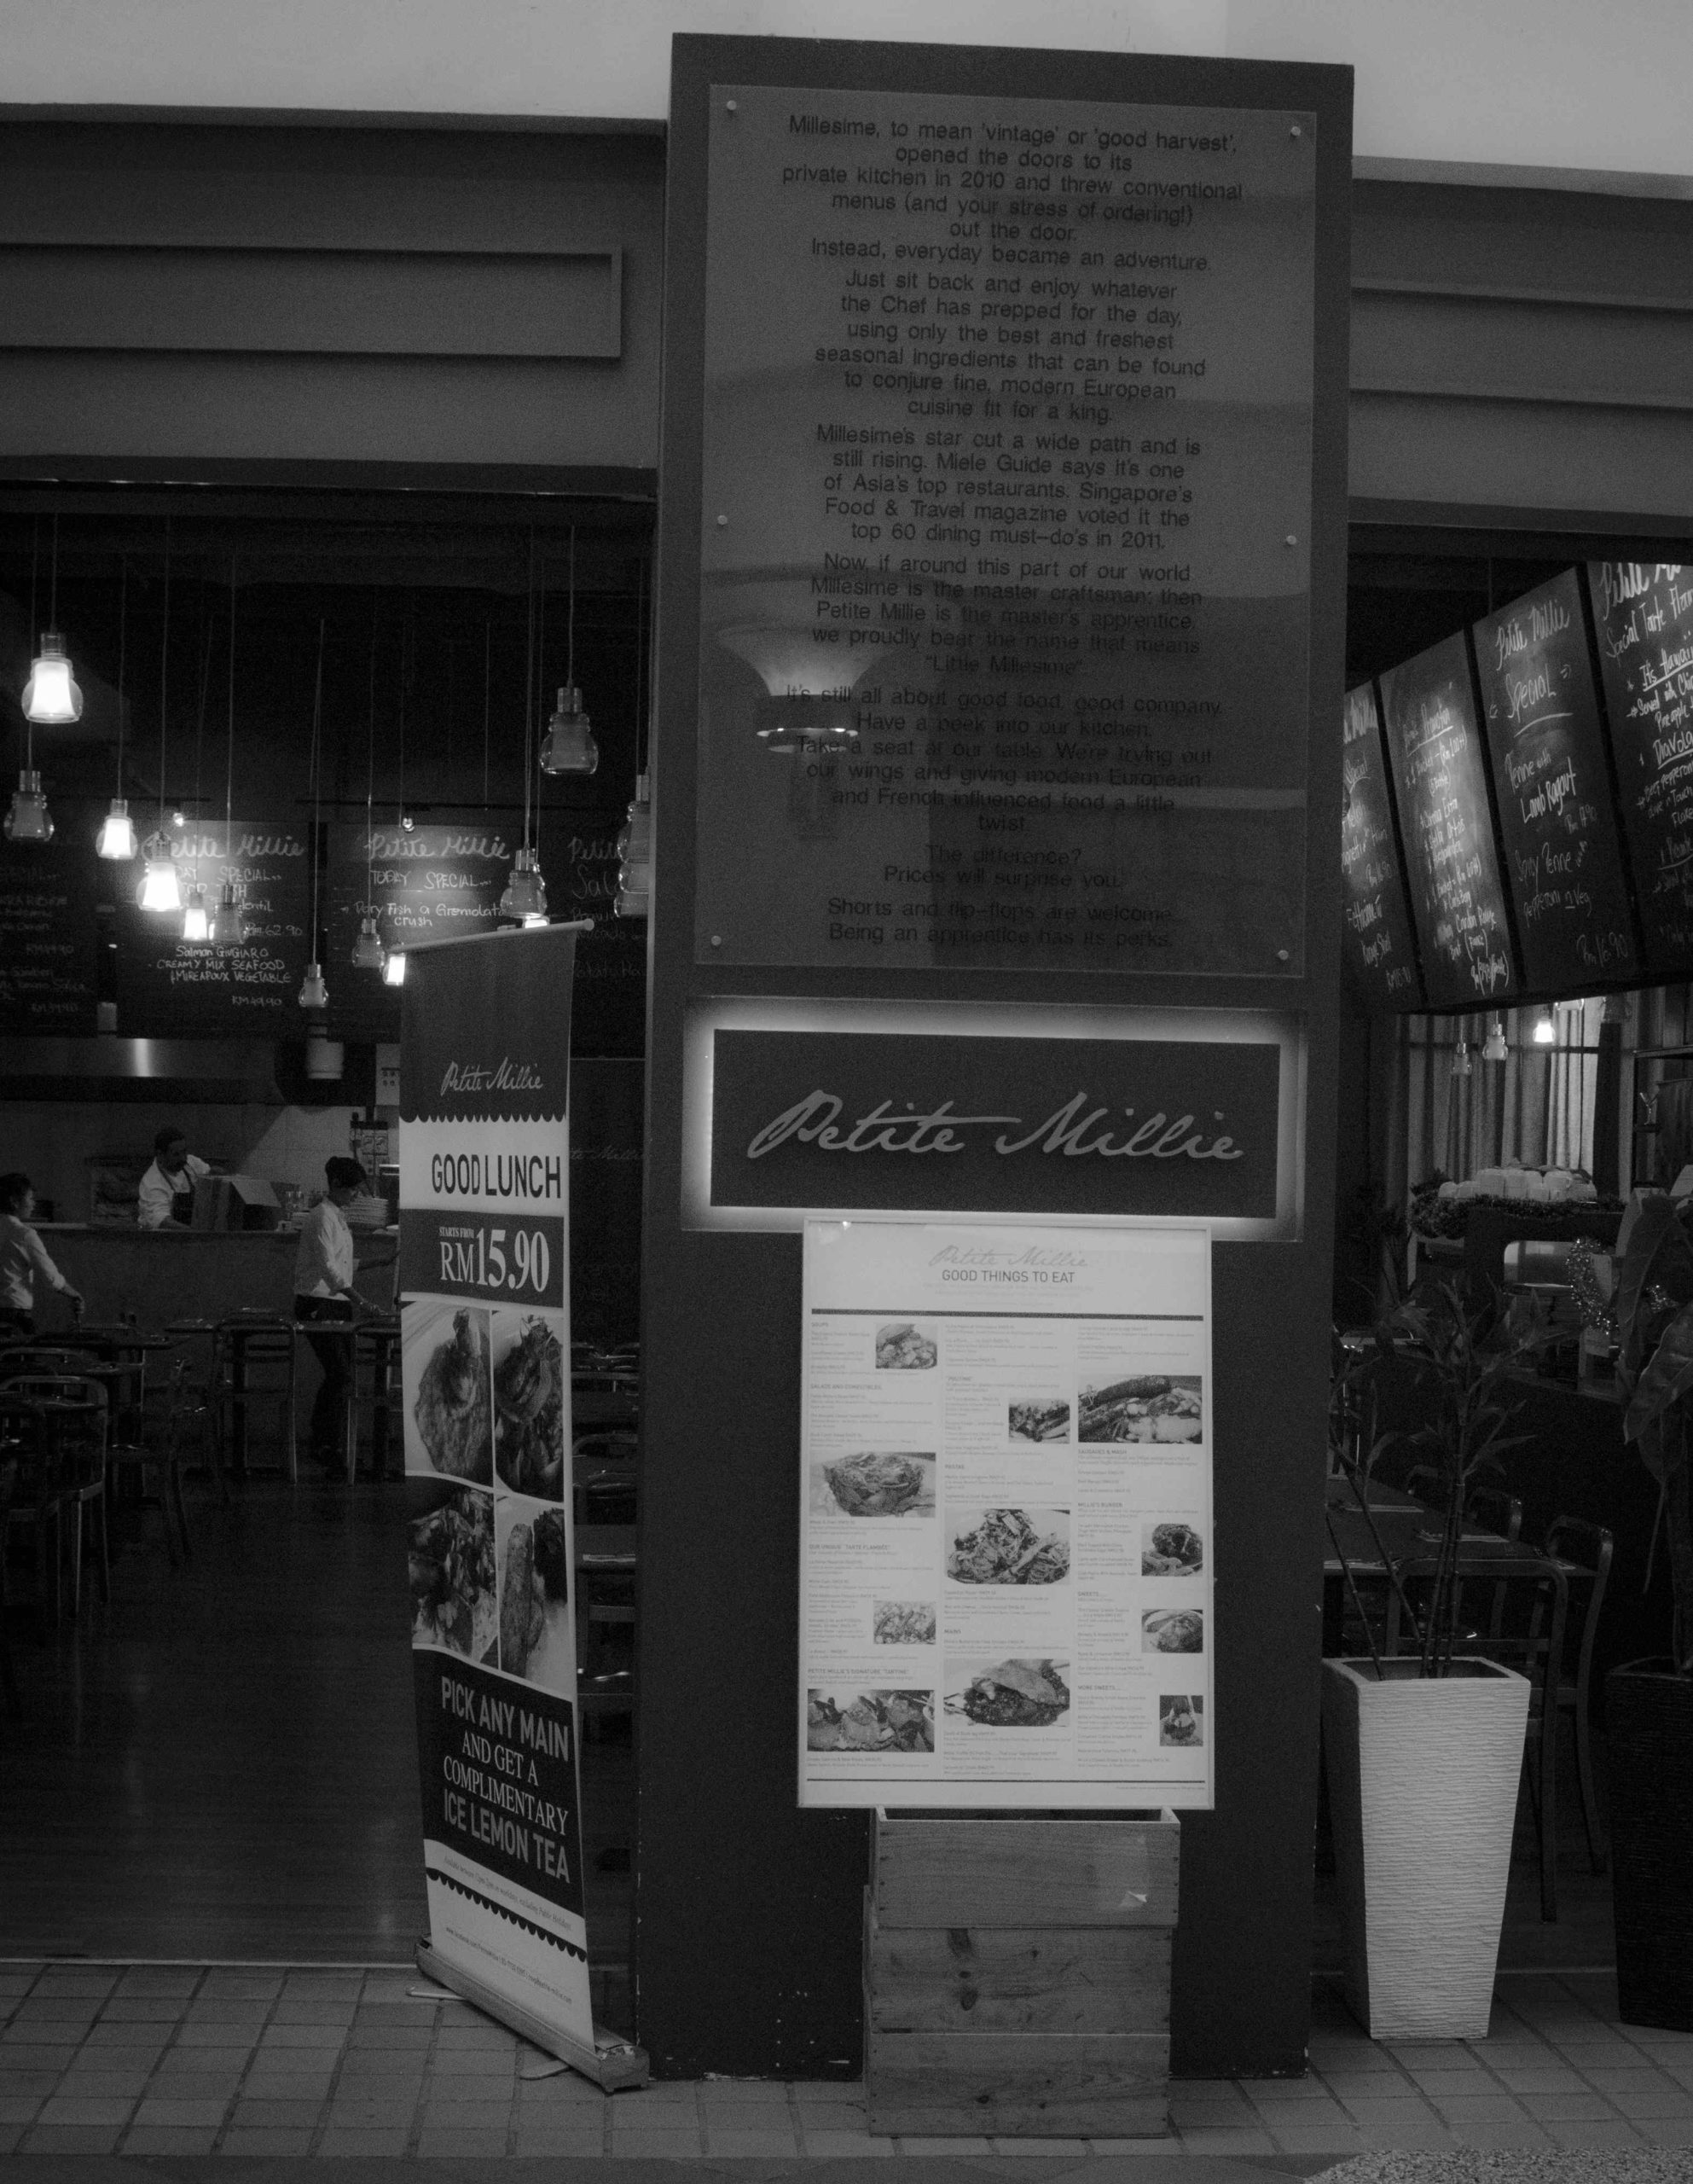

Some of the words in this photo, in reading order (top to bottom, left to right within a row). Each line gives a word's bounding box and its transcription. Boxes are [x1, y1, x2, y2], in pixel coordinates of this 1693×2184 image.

[890, 120, 907, 136] to
[918, 125, 971, 139] mean
[1067, 131, 1087, 144] or
[895, 147, 968, 165] opened
[978, 148, 1007, 165] the
[1018, 149, 1072, 168] doors
[1083, 154, 1101, 169] to
[1110, 154, 1132, 171] its
[781, 164, 847, 183] private
[856, 166, 926, 186] kitchen
[935, 170, 950, 187] in
[960, 171, 1005, 189] 2010
[1015, 175, 1050, 191] and
[1060, 176, 1111, 194] threw
[1122, 182, 1242, 200] conventional
[831, 194, 896, 209] menus
[903, 194, 948, 214] (and
[957, 200, 999, 217] your
[1009, 200, 1067, 217] stress
[1077, 202, 1095, 218] of
[949, 221, 980, 236] out
[989, 221, 1019, 238] the
[810, 237, 885, 258] Instead,
[895, 243, 981, 264] everyday
[991, 245, 1070, 264] became
[1081, 253, 1104, 265] an
[844, 269, 884, 287] Just
[896, 271, 918, 288] sit
[927, 272, 973, 290] back
[985, 276, 1021, 293] and
[1030, 278, 1080, 299] enjoy
[1091, 280, 1176, 299] whatever
[840, 293, 870, 311] the
[880, 295, 926, 313] Chef
[936, 298, 971, 315] has
[980, 302, 1061, 322] prepped
[1070, 303, 1095, 320] for
[1106, 305, 1136, 322] the
[846, 320, 898, 341] using
[907, 322, 946, 343] only
[958, 324, 988, 341] the
[997, 326, 1039, 343] best
[1049, 328, 1087, 346] and
[1096, 330, 1173, 349] freshest
[815, 346, 903, 363] seasonal
[912, 347, 1017, 369] ingredients
[1027, 352, 1063, 369] that
[1073, 357, 1109, 371] can
[1116, 356, 1142, 373] be
[1151, 357, 1206, 375] found
[844, 370, 862, 386] to
[873, 372, 942, 392] conjure
[1000, 377, 1074, 394] modern
[1083, 379, 1176, 401] European
[907, 398, 972, 415] cuisine
[983, 400, 1001, 416] fit
[1012, 401, 1036, 418] for
[1047, 405, 1058, 419] a
[925, 429, 961, 445] star
[971, 432, 1002, 447] cut
[1012, 435, 1023, 448] a
[1035, 433, 1079, 450] wide
[1088, 436, 1131, 455] path
[1140, 438, 1177, 454] and
[1185, 439, 1200, 455] is
[832, 449, 862, 466] still
[872, 450, 927, 472] rising.
[936, 452, 986, 470] Miele
[996, 455, 1051, 473] Guide
[1062, 461, 1105, 479] says
[1115, 460, 1139, 476] it's
[1149, 464, 1184, 478] one
[823, 473, 842, 490] of
[853, 473, 908, 492] Asia's
[916, 477, 947, 497] top
[1079, 482, 1192, 505] Singapore's
[824, 497, 876, 514] Food
[884, 498, 898, 515] &
[911, 500, 965, 518] Travel
[973, 504, 1066, 523] magazine
[1077, 508, 1129, 524] voted
[1138, 508, 1150, 525] it
[1159, 509, 1189, 526] the
[850, 524, 881, 544] top
[890, 525, 916, 542] 60
[925, 526, 981, 548] dining
[1095, 532, 1111, 549] in
[878, 555, 890, 571] if
[900, 557, 967, 573] around
[977, 558, 1010, 575] this
[1019, 561, 1059, 580] part
[1069, 562, 1087, 578] of
[1096, 566, 1127, 579] our
[1138, 566, 1191, 582] world
[363, 834, 434, 862] Petite
[444, 835, 510, 860] Millie
[394, 915, 433, 927] crush
[231, 959, 285, 971] SEAFOOD
[441, 1061, 492, 1096] Petite
[485, 1057, 543, 1091] Millie
[747, 1089, 1021, 1159] Petite
[996, 1091, 1244, 1160] Millie
[432, 1153, 480, 1195] GOOD
[484, 1155, 561, 1199] LUNCH
[929, 1245, 1017, 1267] Petite
[1008, 1246, 1088, 1267] Millie
[942, 1269, 977, 1281] GOOD
[982, 1270, 1029, 1283] THINGS
[1033, 1271, 1048, 1282] TO
[1052, 1271, 1075, 1283] EAT
[441, 1676, 477, 1724] PICK
[478, 1694, 515, 1740] ANY
[519, 1709, 569, 1763] MAIN
[461, 1729, 491, 1765] AND
[494, 1744, 525, 1780] GET
[527, 1759, 540, 1786] A
[444, 1755, 569, 1836] COMPLIMENTARY
[444, 1788, 467, 1832] ICE
[470, 1802, 529, 1863] LEMON
[532, 1833, 571, 1885] TEA
